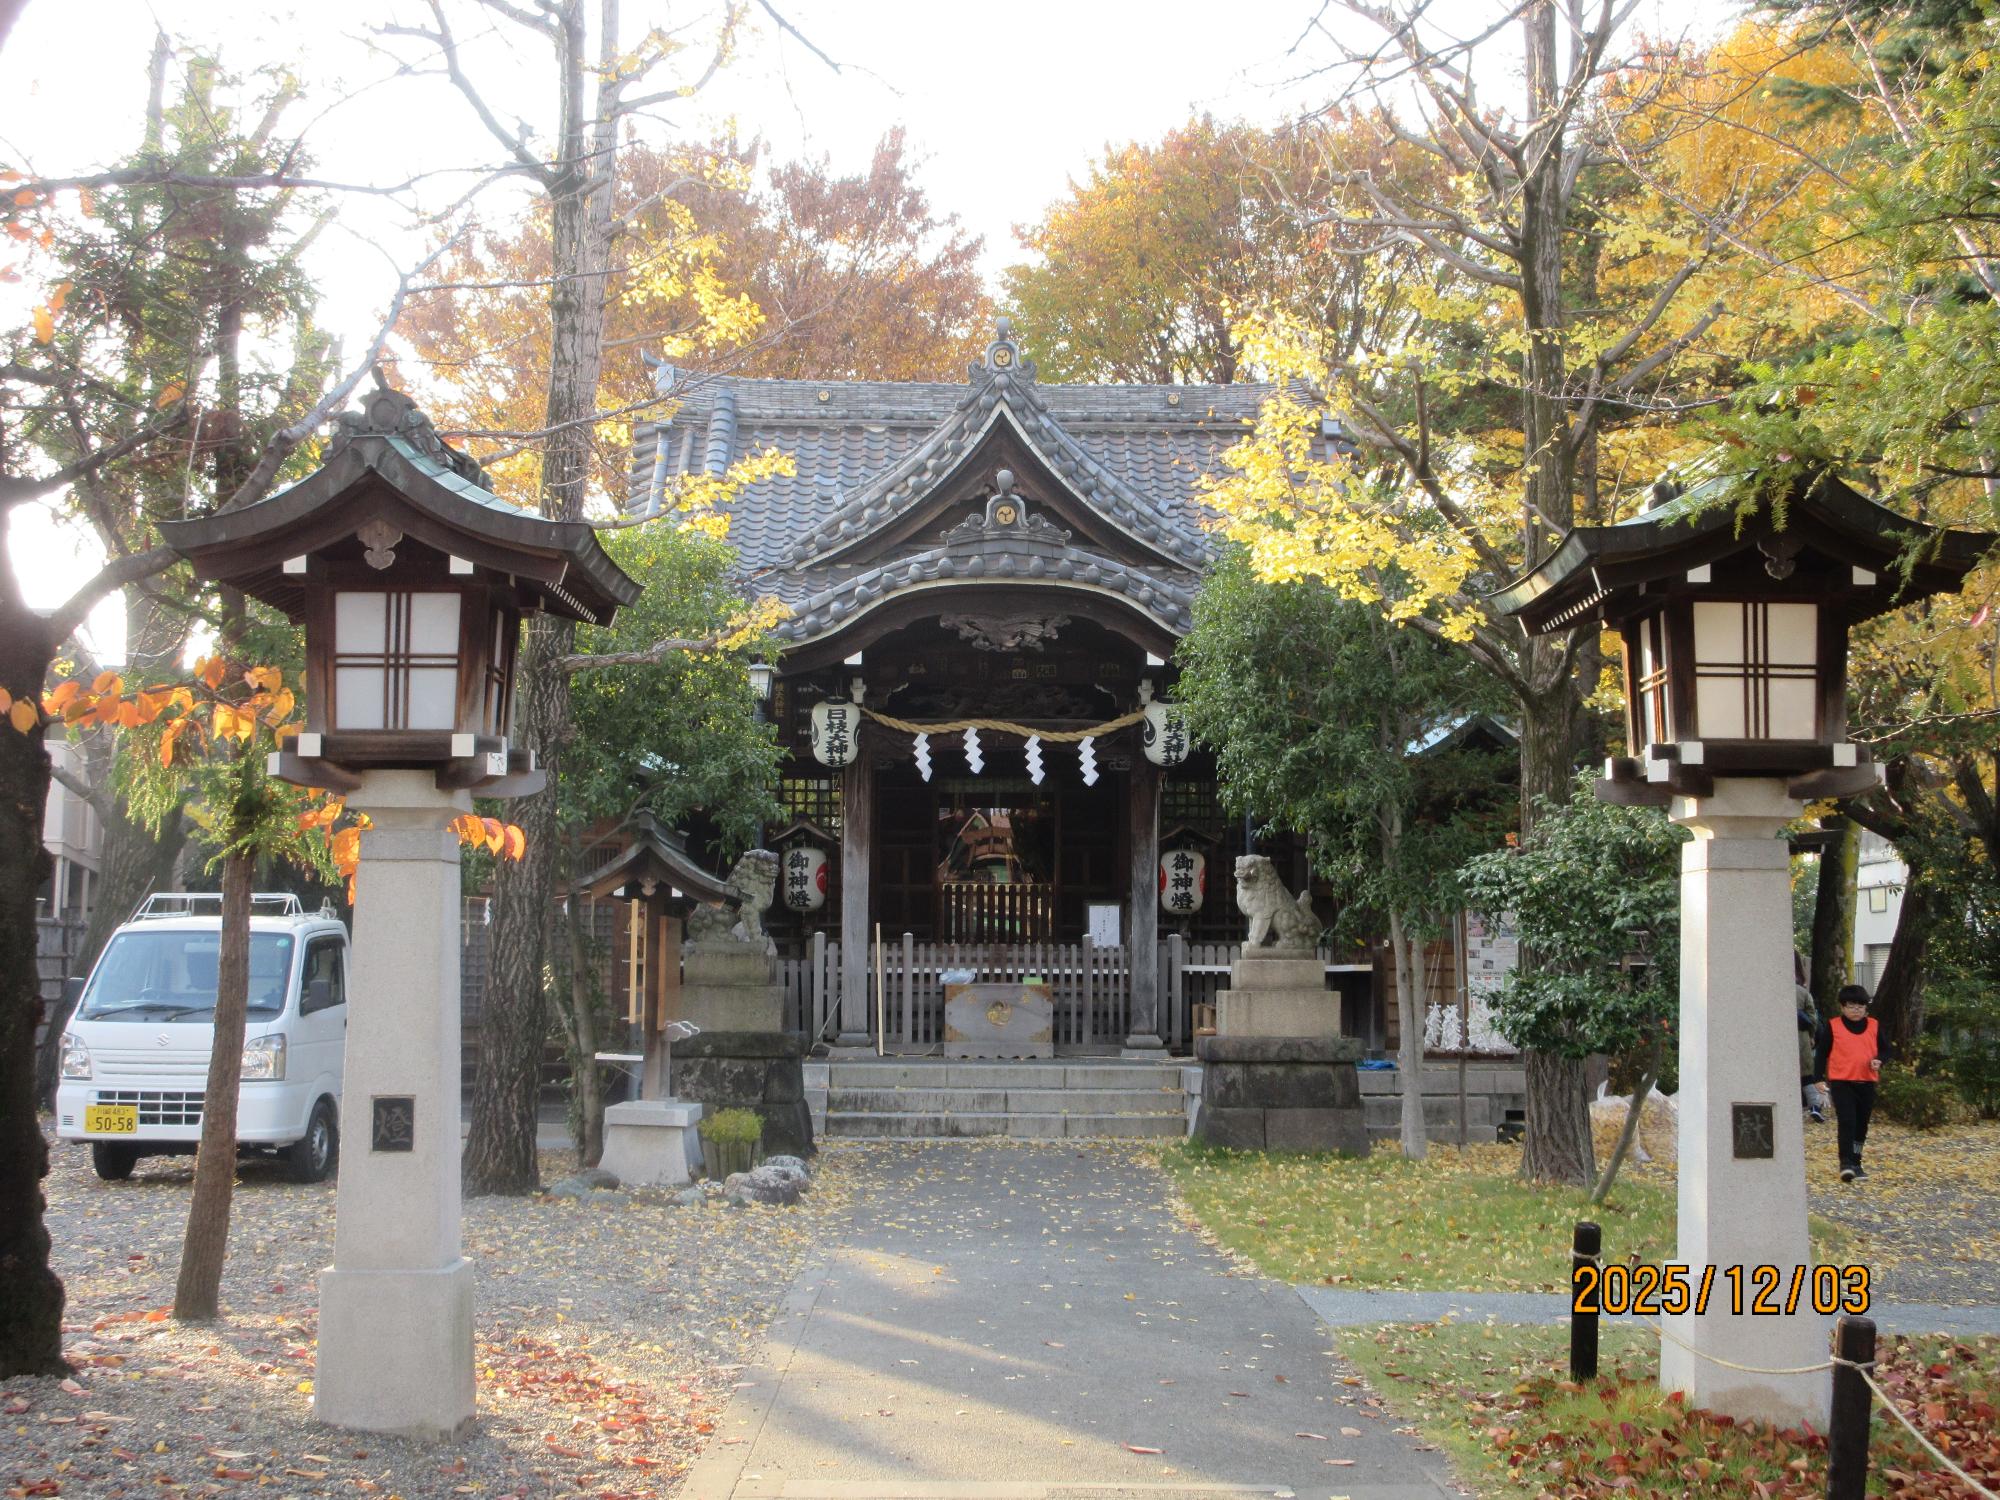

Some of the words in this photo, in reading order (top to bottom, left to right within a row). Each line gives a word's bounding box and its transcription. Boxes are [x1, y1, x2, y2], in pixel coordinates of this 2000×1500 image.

[825, 708, 849, 766] 日枝大神社
[1162, 709, 1185, 766] 枝大神社
[95, 1116, 133, 1131] 50-58
